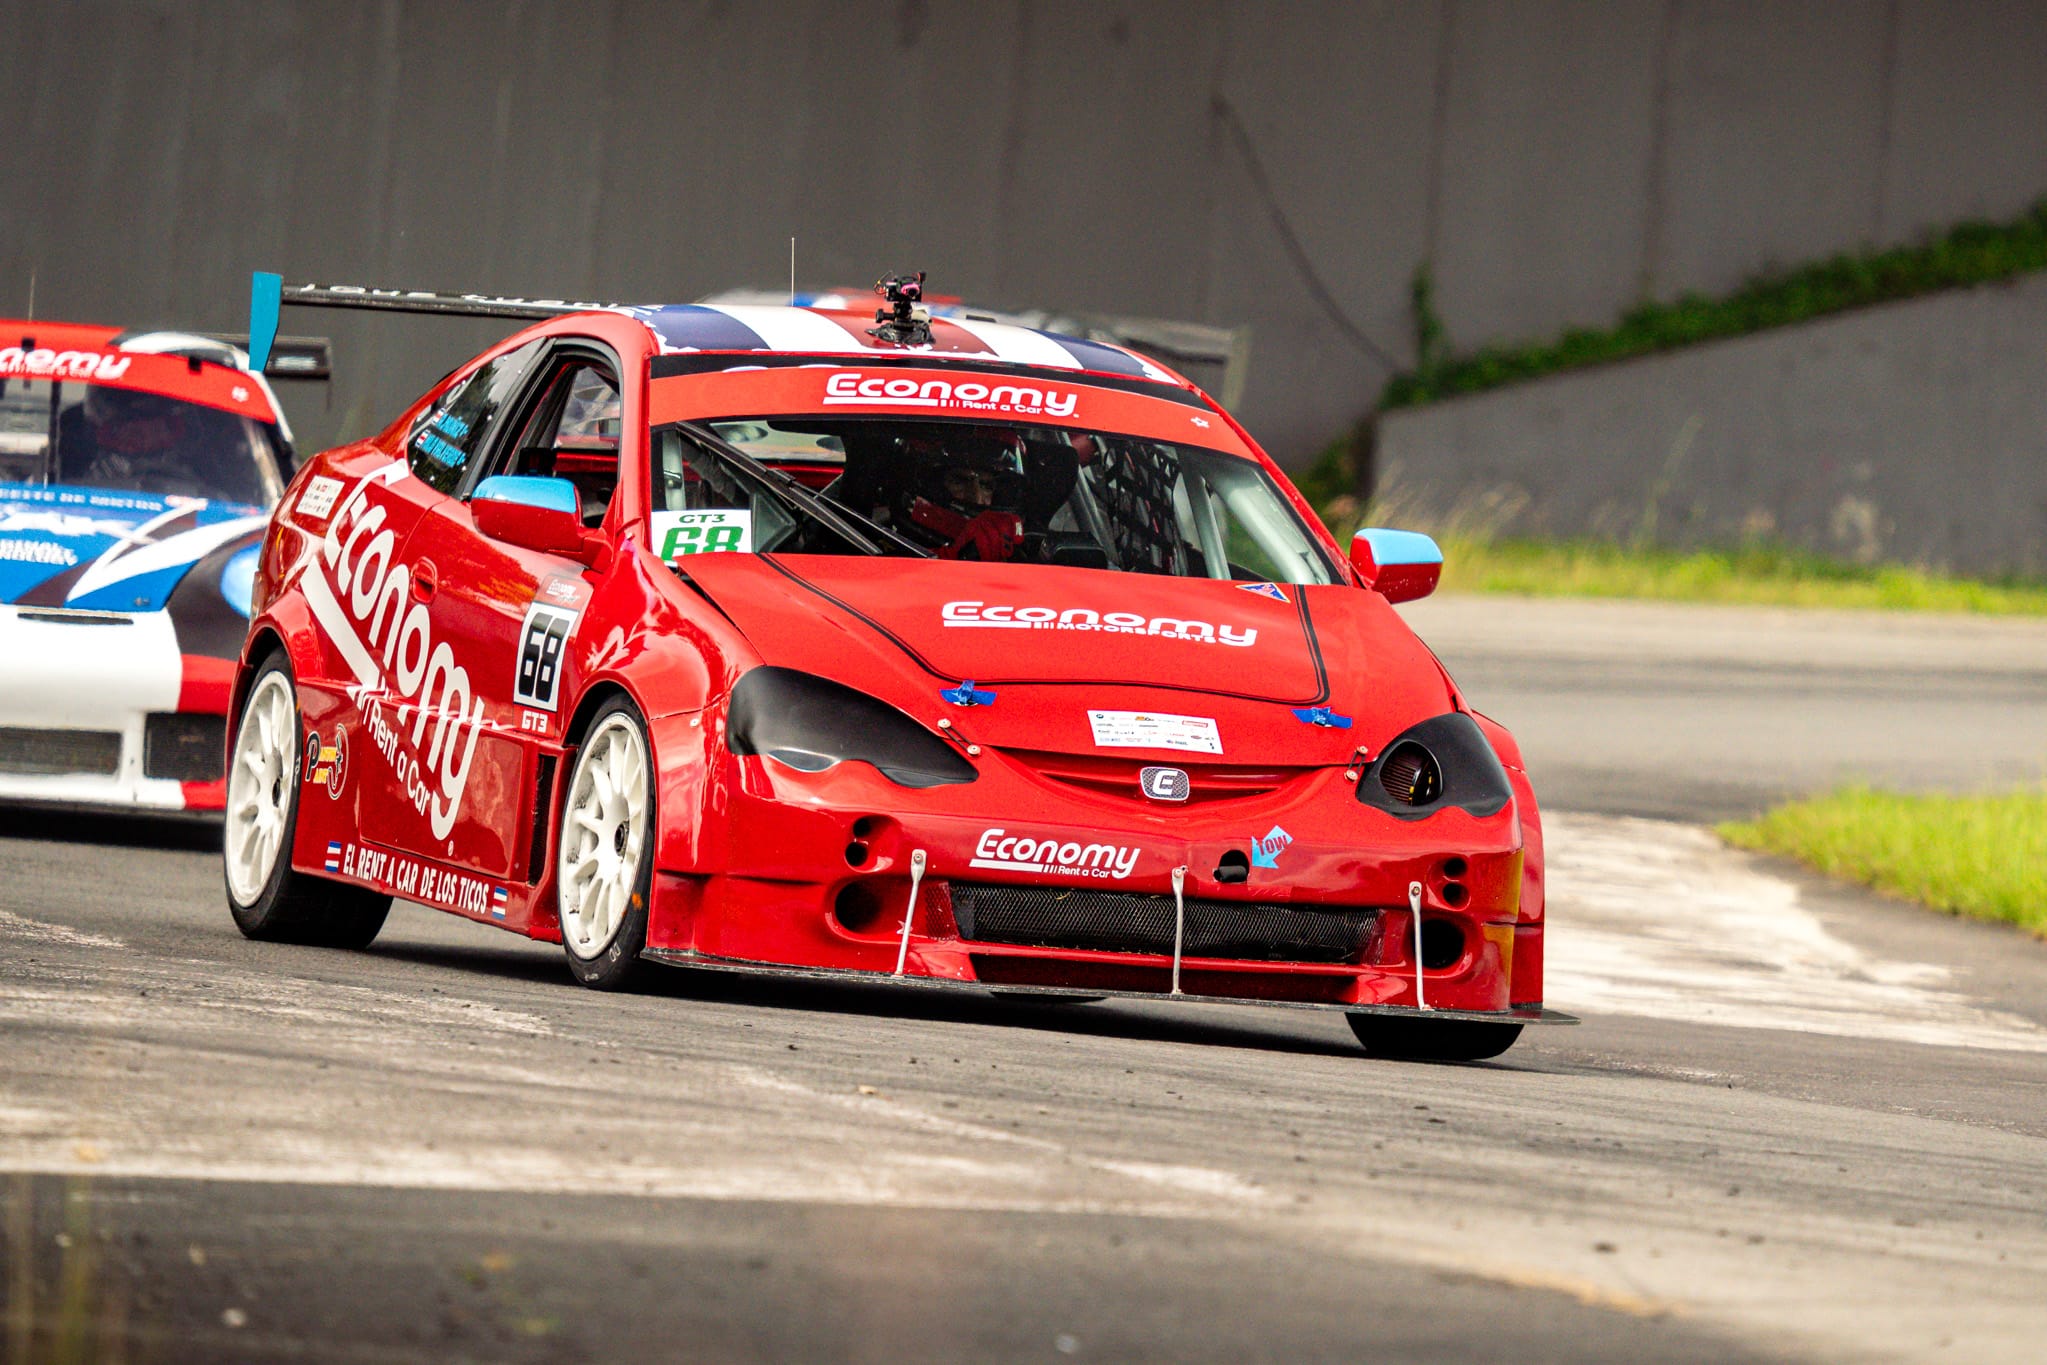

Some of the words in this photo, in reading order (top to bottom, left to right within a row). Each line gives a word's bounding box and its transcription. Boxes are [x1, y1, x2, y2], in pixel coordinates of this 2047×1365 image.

[826, 373, 1077, 417] Economy
[962, 400, 996, 411] Rent
[1000, 403, 1010, 411] a
[1014, 404, 1042, 415] Car
[679, 514, 726, 523] GT3
[661, 526, 743, 561] 68
[941, 601, 1258, 647] Economy
[1057, 622, 1216, 644] MOTORSPORTS
[324, 458, 485, 841] Economy
[518, 612, 569, 702] 68
[521, 709, 549, 733] GT3
[368, 699, 398, 767] Rent
[396, 750, 407, 782] a
[407, 760, 431, 816] Car
[1152, 770, 1178, 796] E
[975, 828, 1141, 879] Economy
[1058, 865, 1080, 876] Rent
[1081, 869, 1088, 877] a
[1091, 868, 1110, 879] Car
[343, 843, 356, 874] EL
[356, 847, 387, 881] RENT
[386, 856, 395, 888] A
[396, 859, 419, 895] CAR
[419, 866, 434, 899] DE
[435, 871, 458, 905] LOS
[458, 877, 490, 914] TICOS
